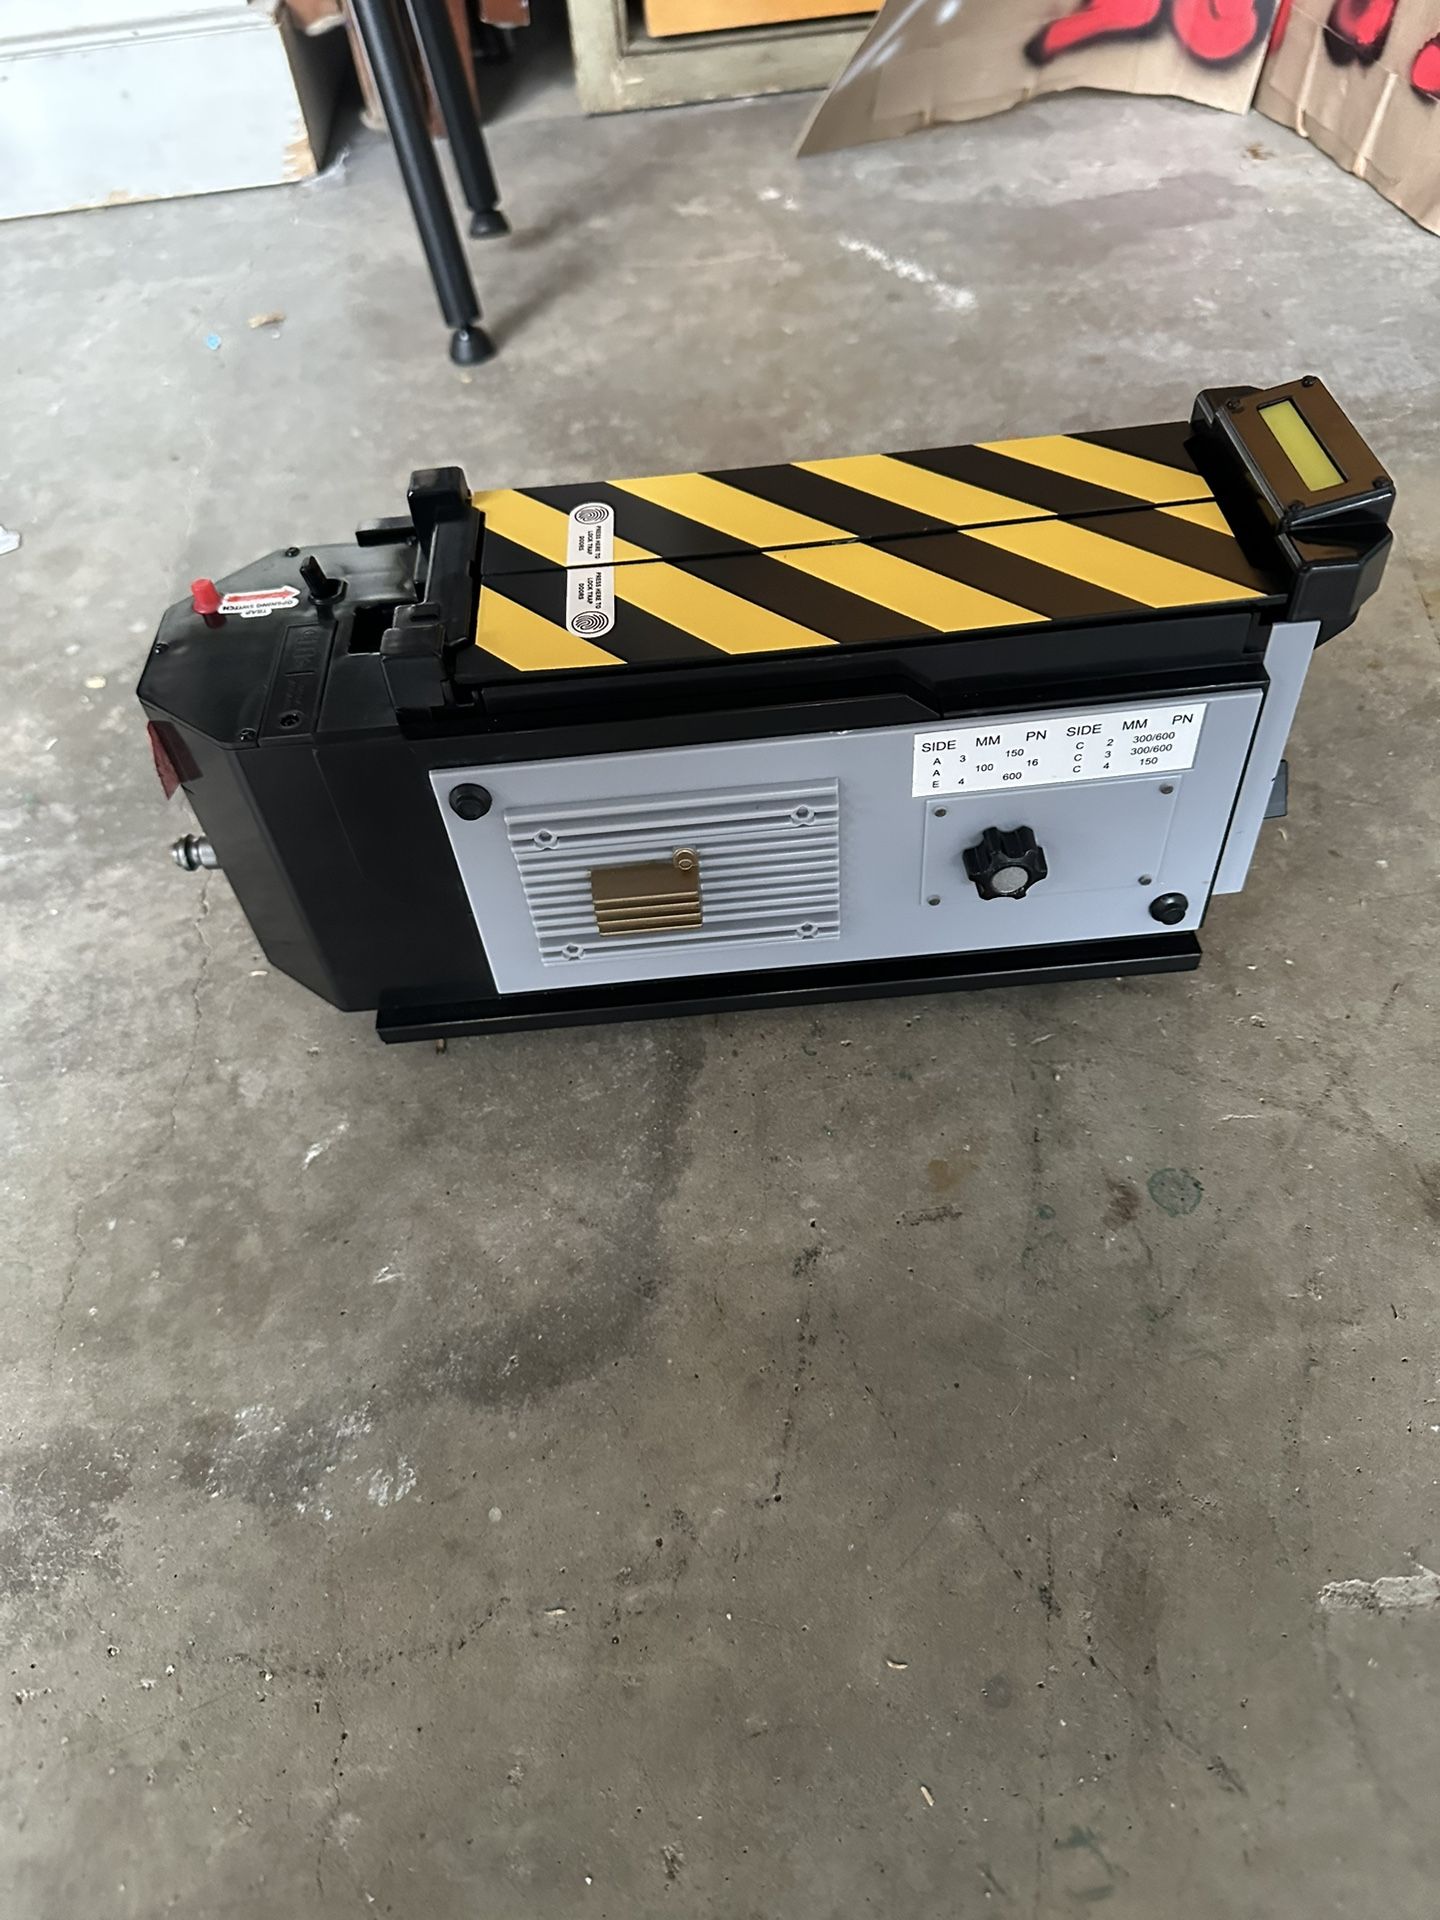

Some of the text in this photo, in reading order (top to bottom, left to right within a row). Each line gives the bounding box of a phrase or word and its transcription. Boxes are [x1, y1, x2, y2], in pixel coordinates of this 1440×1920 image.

[921, 714, 1194, 752] SIDE MM PN SIDE MM PN
[933, 731, 1175, 766] A 3 150 C 2 300/600
[932, 744, 1172, 777] A 100 16 C 3 300/600
[932, 757, 1158, 788] E 4 600 C 4 150
